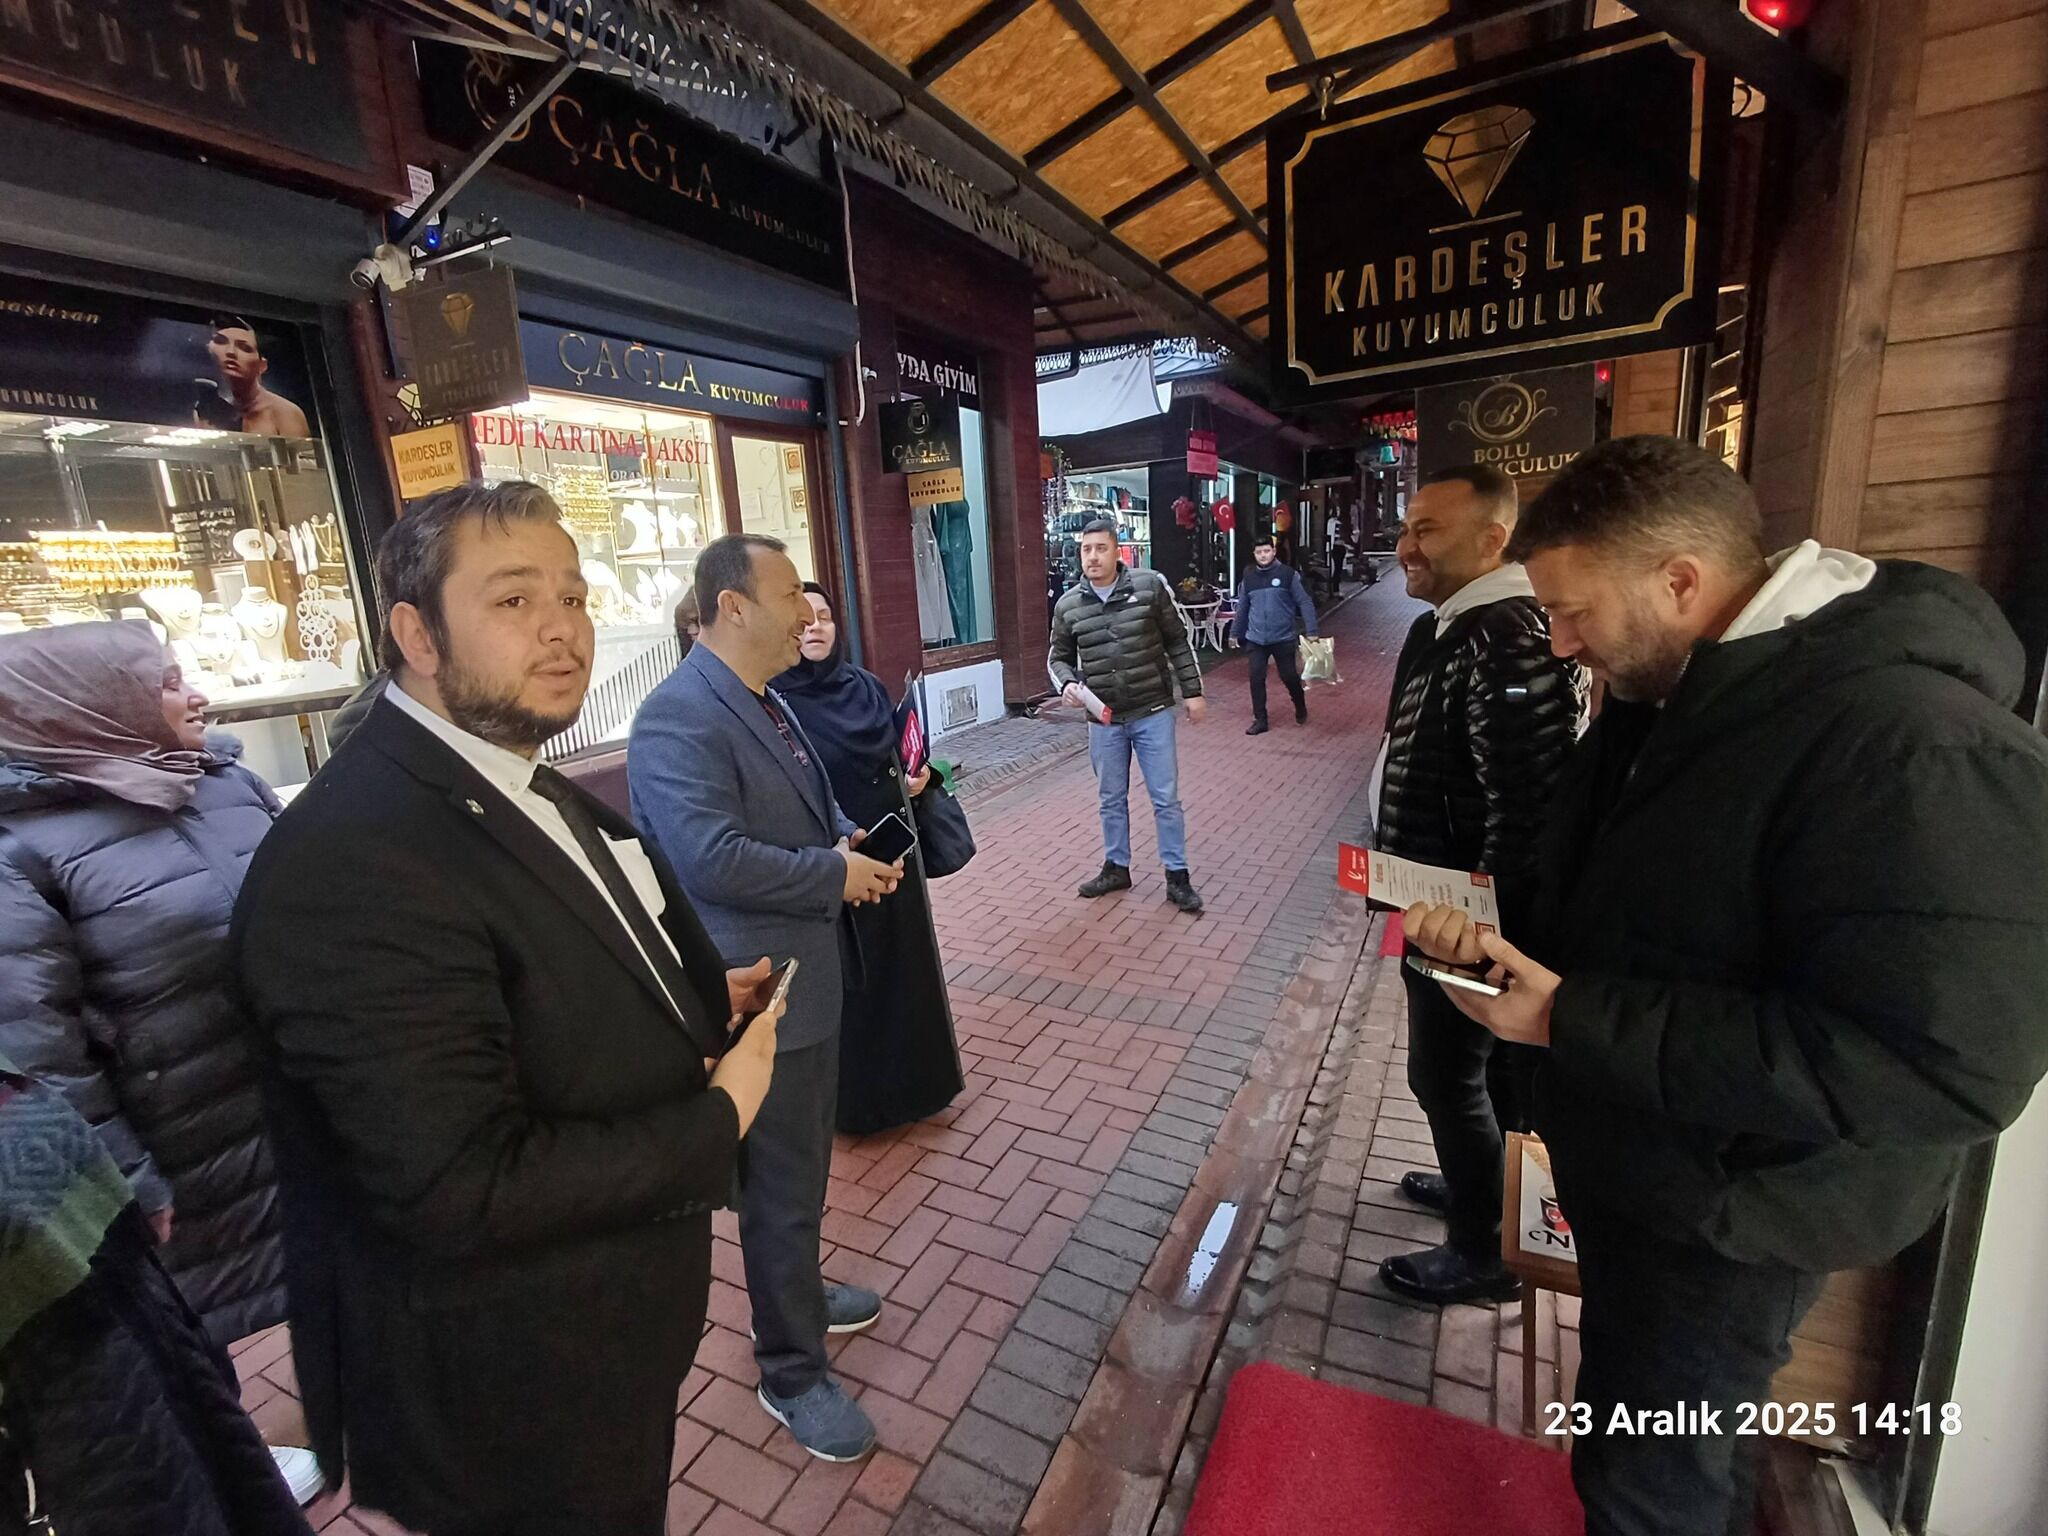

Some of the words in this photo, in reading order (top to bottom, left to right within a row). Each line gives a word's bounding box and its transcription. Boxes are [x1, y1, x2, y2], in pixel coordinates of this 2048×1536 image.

[548, 94, 720, 208] ÇAĞLA
[1323, 204, 1648, 314] KARDEŞLER
[1352, 282, 1605, 357] KUYUMCULUK
[557, 332, 704, 395] ÇAĞLA
[933, 359, 977, 396] GİYİM
[709, 383, 809, 412] KUYUMCULUK
[397, 440, 454, 463] KARDEŞLER
[533, 420, 643, 458] KARTINA
[643, 432, 710, 465] TAKSİT
[892, 439, 951, 464] ÇAĞLA
[1473, 442, 1531, 464] BOLU
[1497, 452, 1581, 476] CULUK
